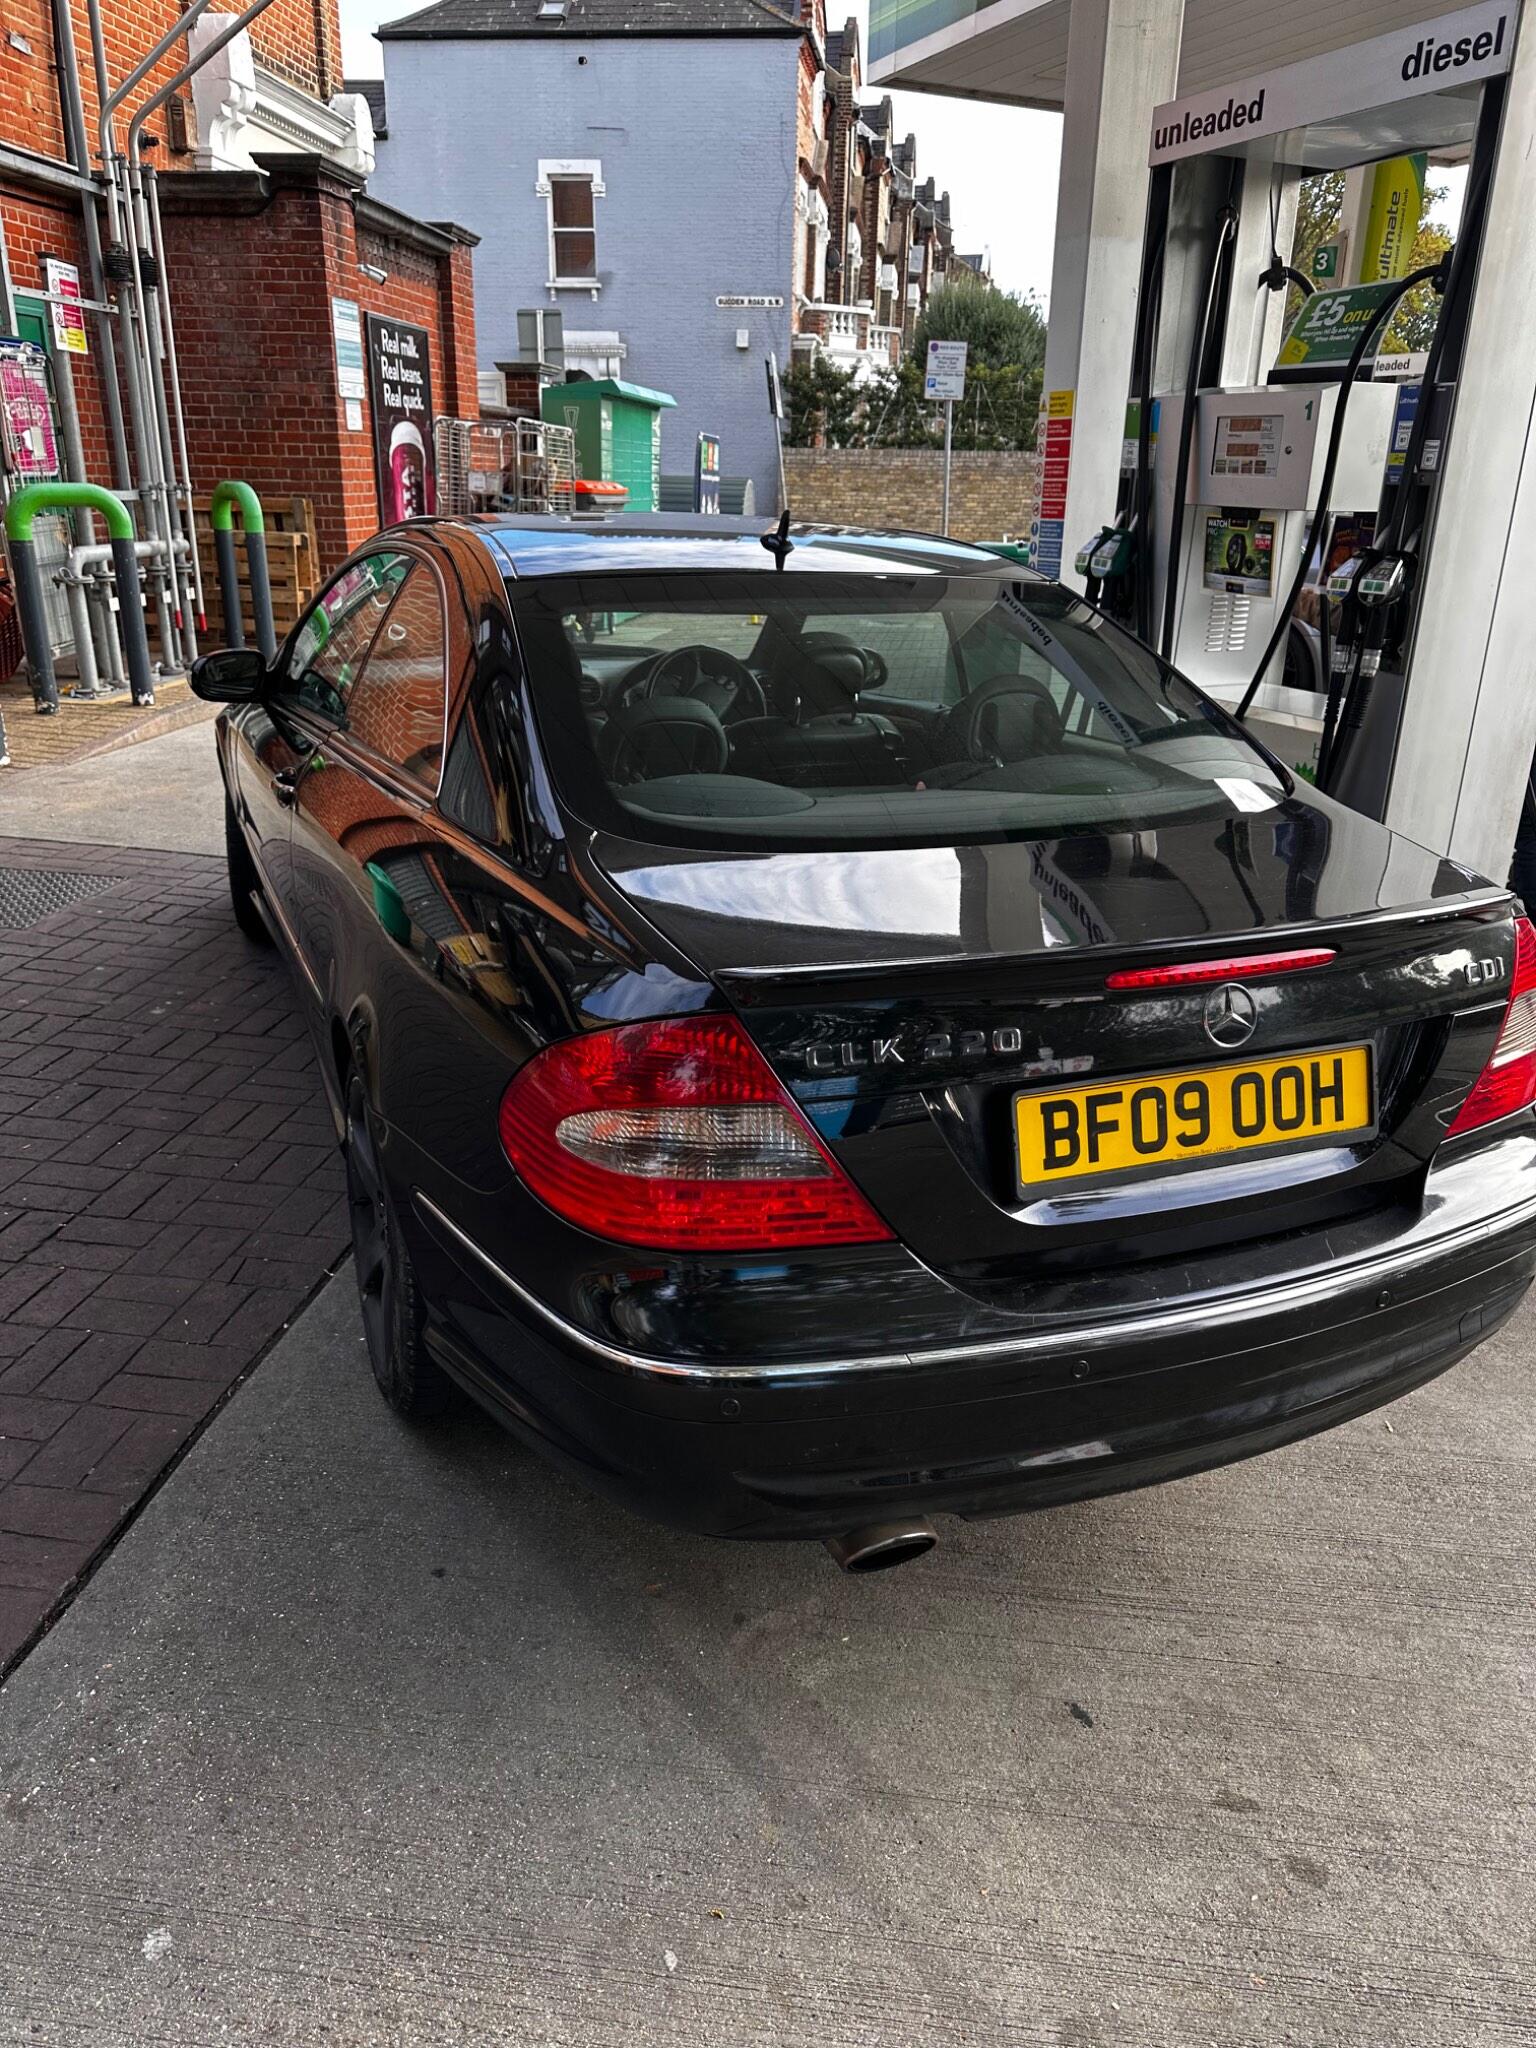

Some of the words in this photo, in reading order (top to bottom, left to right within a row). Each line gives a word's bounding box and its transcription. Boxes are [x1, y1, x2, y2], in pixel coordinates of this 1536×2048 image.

[1401, 16, 1507, 81] diesel
[1155, 89, 1265, 150] unleaded
[1380, 191, 1400, 279] ultimate
[1315, 252, 1328, 270] 3
[748, 298, 766, 306] ROAD
[1304, 295, 1352, 328] £5
[1343, 310, 1361, 324] on
[381, 328, 400, 354] Real
[400, 335, 419, 359] milk.
[381, 355, 400, 381] Real
[400, 359, 423, 385] beans.
[1376, 359, 1410, 372] leaded
[383, 383, 402, 408] Real
[403, 388, 425, 417] quick.
[1305, 400, 1313, 420] 1
[1208, 519, 1227, 528] WATCH
[1464, 957, 1505, 984] CDI
[806, 1035, 904, 1070] CLK
[921, 1028, 1022, 1065] 220
[1040, 1080, 1210, 1171] BF09
[1230, 1058, 1344, 1138] OOH
